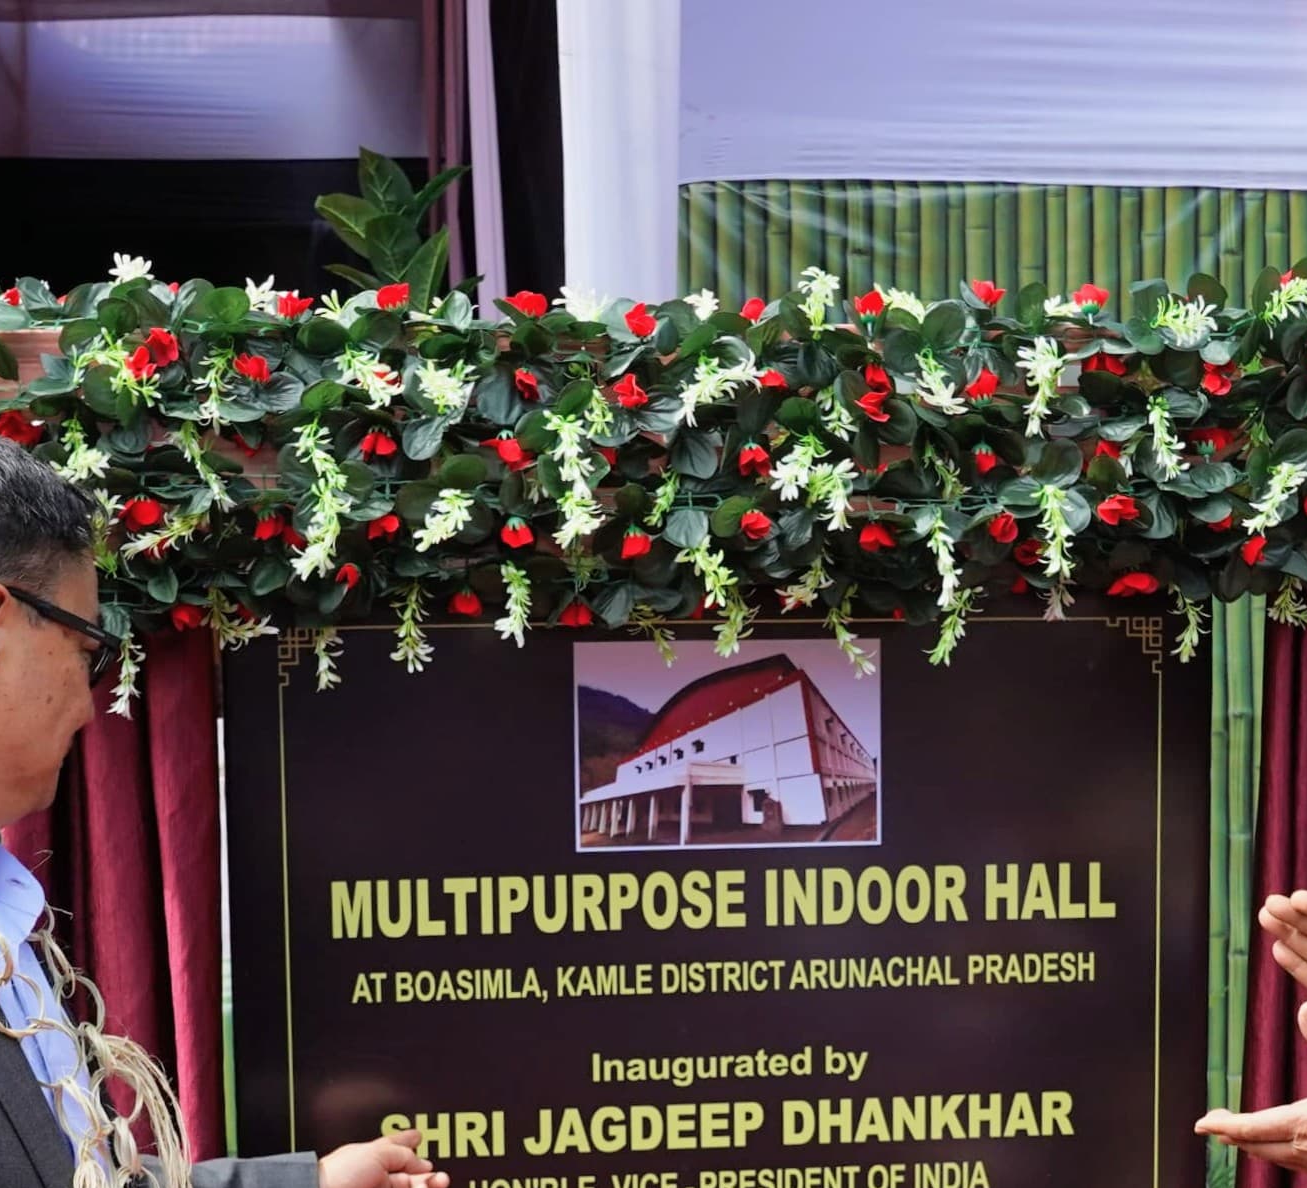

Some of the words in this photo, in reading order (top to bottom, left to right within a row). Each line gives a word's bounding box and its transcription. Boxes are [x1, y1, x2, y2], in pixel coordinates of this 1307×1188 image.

[330, 869, 747, 939] MULTIPURPOSE
[765, 864, 969, 927] INDOOR
[985, 861, 1117, 921] HALL
[352, 972, 387, 1004] AT
[395, 967, 549, 1003] BOASIMLA,
[556, 963, 653, 997] KAMLE
[661, 959, 785, 994] DISTRICT
[788, 955, 960, 990] ARUNACHAL
[967, 951, 1095, 985] PRADESH
[592, 1045, 813, 1087] Inaugurated
[824, 1045, 869, 1082] by
[523, 1101, 765, 1156] JAGDEEP
[782, 1090, 1075, 1146] DHANKHAR
